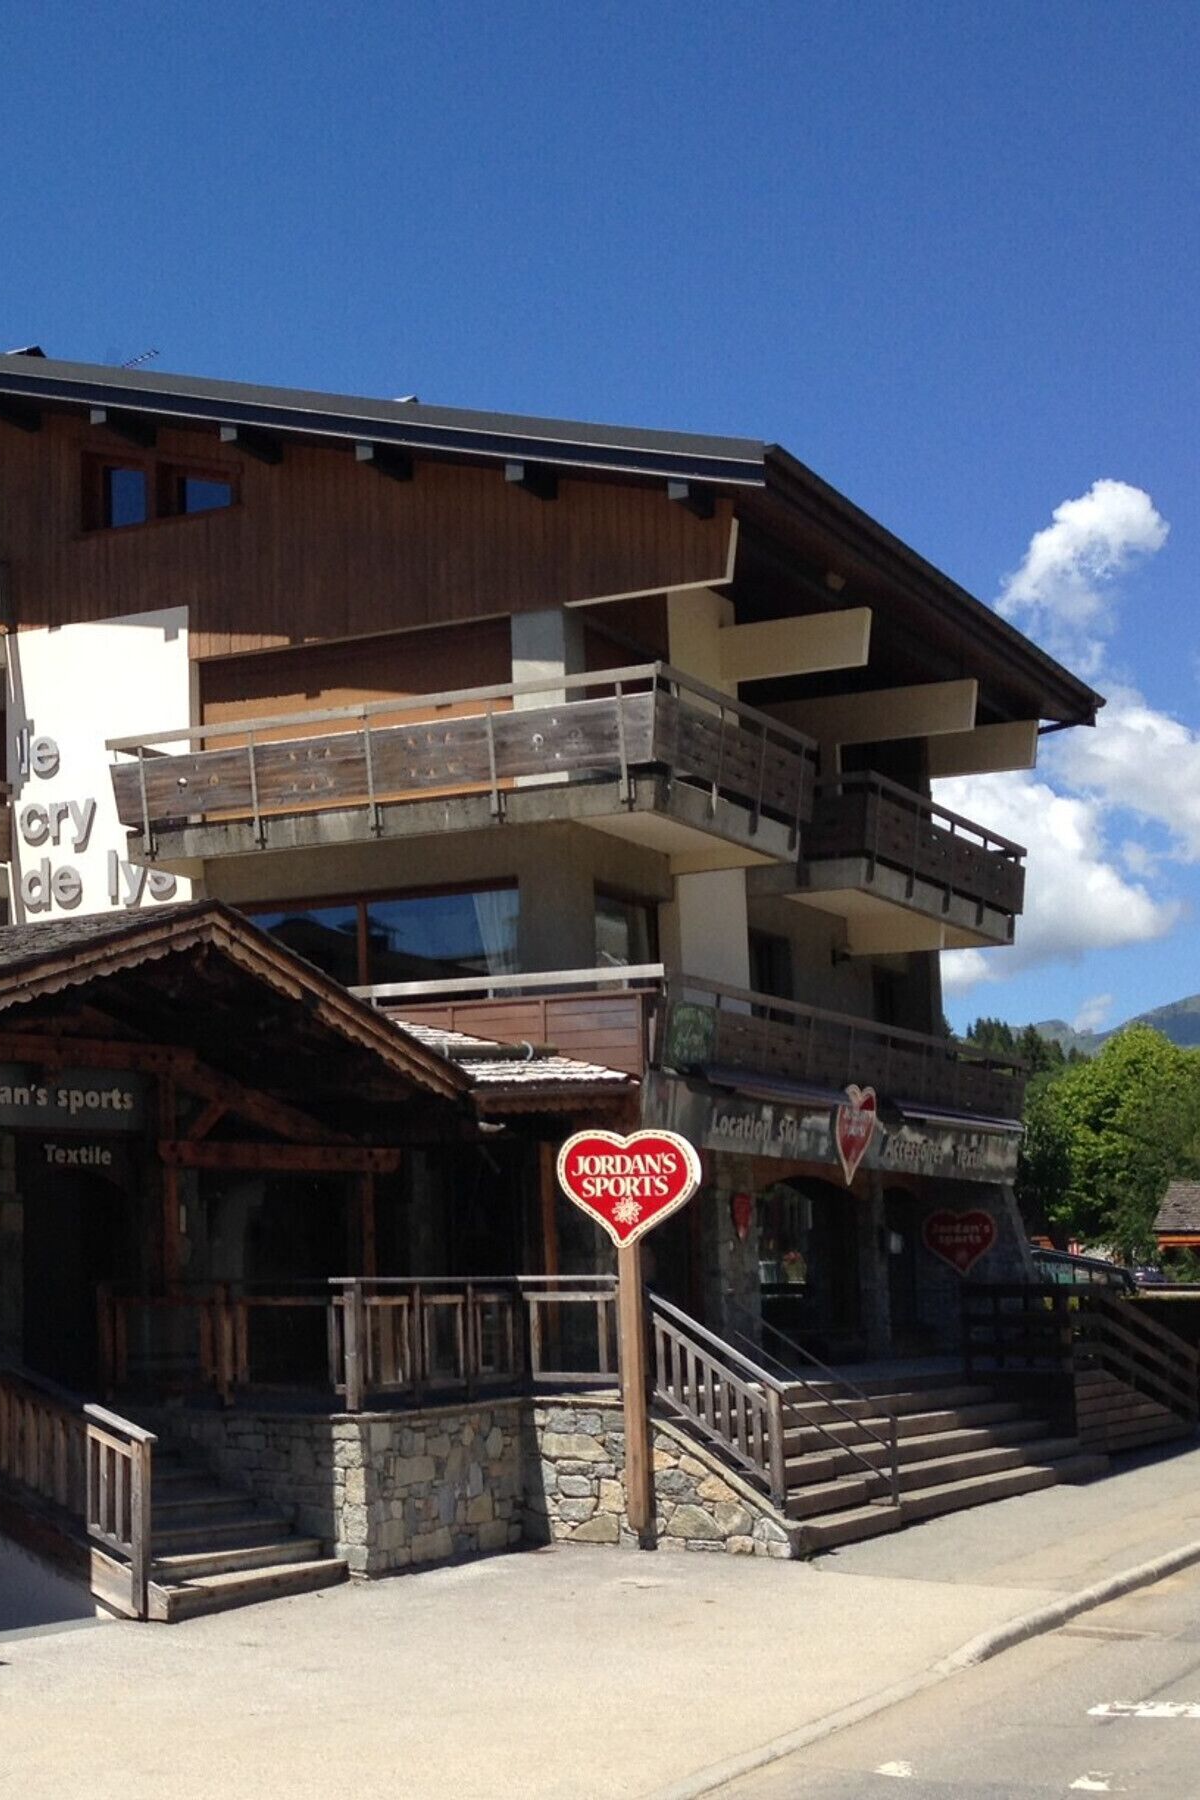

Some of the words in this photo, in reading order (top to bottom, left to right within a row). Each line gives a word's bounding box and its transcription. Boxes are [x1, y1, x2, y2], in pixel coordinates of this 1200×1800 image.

[18, 728, 59, 779] le
[20, 798, 96, 853] cry
[21, 857, 82, 913] de
[57, 1087, 134, 1115] sports
[711, 1108, 773, 1143] Location
[43, 1143, 112, 1165] Textile
[571, 1152, 677, 1177] JORDAN'S
[581, 1175, 669, 1198] SPORTS
